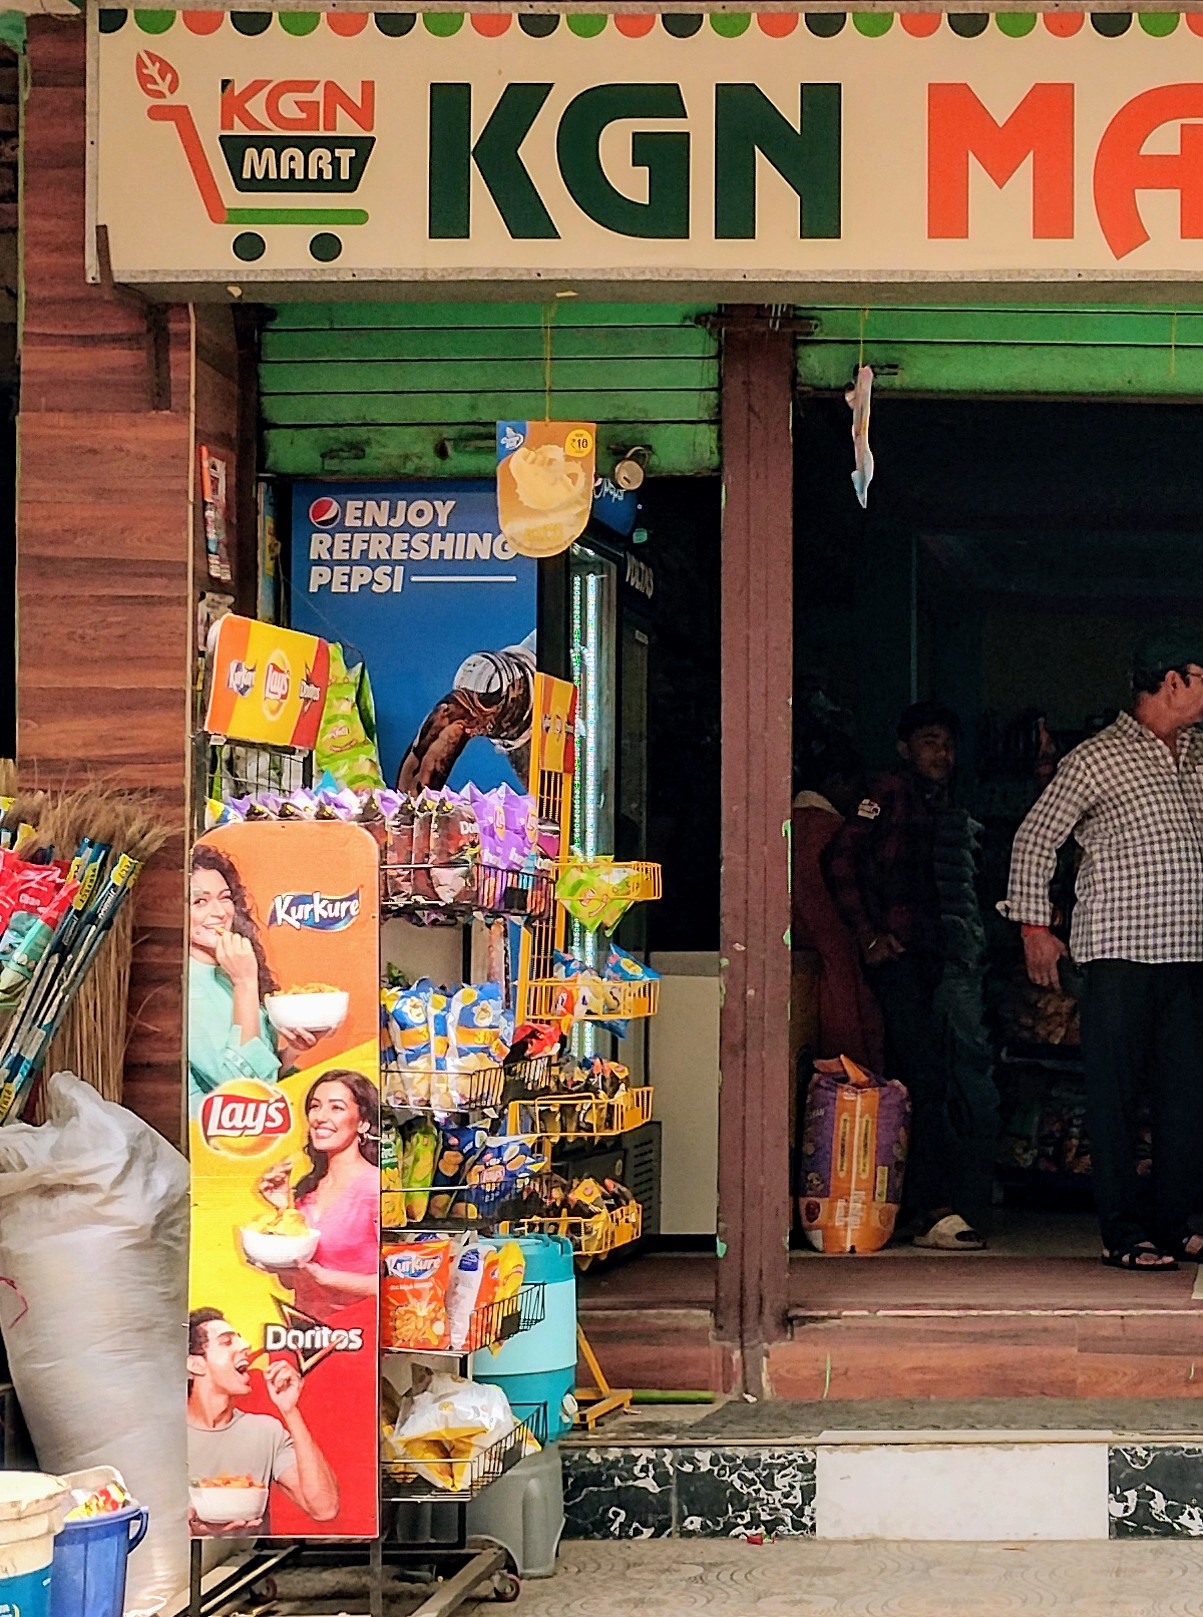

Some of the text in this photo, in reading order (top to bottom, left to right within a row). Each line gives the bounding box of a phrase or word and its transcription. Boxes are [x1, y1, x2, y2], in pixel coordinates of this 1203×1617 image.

[220, 79, 375, 131] KGN
[241, 146, 356, 181] MART
[428, 82, 842, 239] KGN
[344, 500, 456, 528] ENJOY
[309, 532, 519, 561] REFRESHING
[309, 565, 404, 593] PEPSI
[206, 1096, 286, 1137] Lay's
[266, 1325, 363, 1350] Doritos
